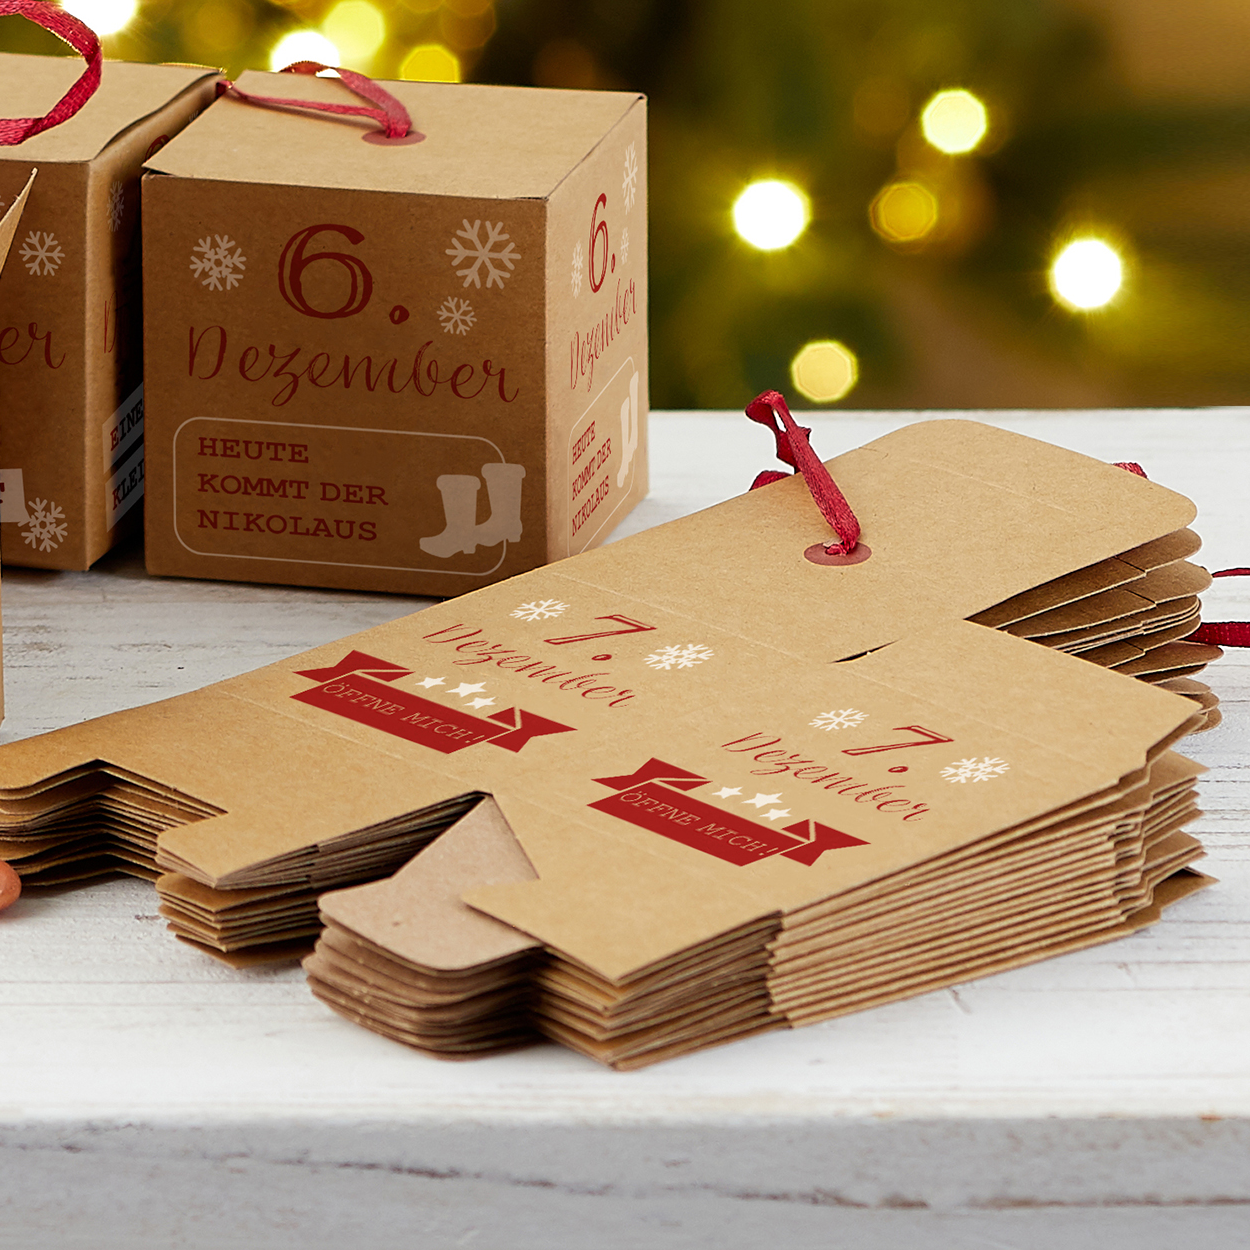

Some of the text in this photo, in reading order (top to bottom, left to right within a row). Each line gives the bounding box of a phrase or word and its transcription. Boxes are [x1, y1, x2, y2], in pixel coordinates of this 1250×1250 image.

[278, 223, 410, 325] 6.
[588, 193, 616, 294] 6.
[188, 324, 519, 407] Dezember
[570, 277, 637, 393] Dezember
[197, 436, 309, 464] HEUTE
[571, 420, 596, 466] HEUTE
[571, 437, 612, 501] KOMMT DER
[197, 473, 389, 506] KOMMT DER
[571, 474, 610, 537] NIKOLAUS
[196, 509, 378, 542] NIKOLAUS
[422, 623, 636, 708] Dezember
[543, 614, 658, 661] 7.
[323, 682, 486, 744] ÖFFNE MICH!
[721, 732, 930, 822] Dezember
[841, 725, 955, 774] 7.
[620, 790, 779, 856] ÖFFNE MICH!
